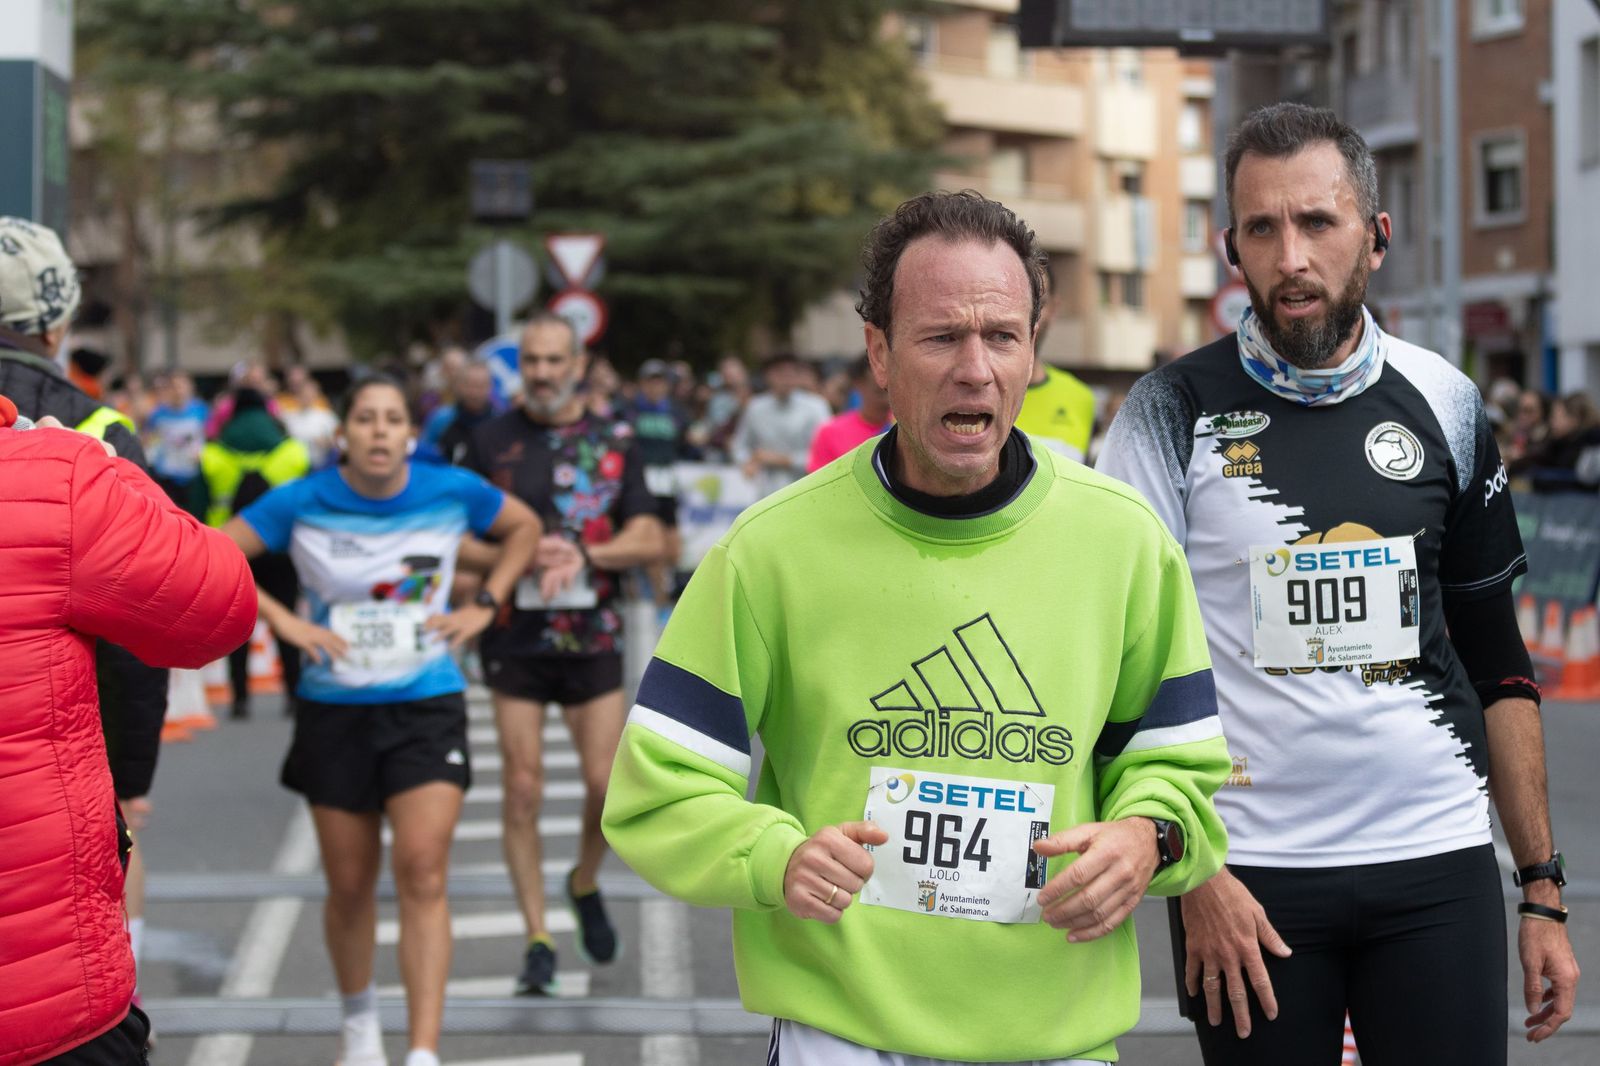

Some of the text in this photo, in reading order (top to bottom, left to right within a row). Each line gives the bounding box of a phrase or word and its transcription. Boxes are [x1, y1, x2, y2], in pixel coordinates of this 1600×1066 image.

[1294, 546, 1401, 572] SETEL
[1287, 575, 1367, 626] 909
[1315, 625, 1343, 636] ALEX
[1327, 643, 1372, 653] Ayuntamiento
[1338, 653, 1372, 662] Salamanca
[1361, 667, 1408, 686] grupo
[847, 708, 1074, 766] adidas
[918, 780, 1036, 813] SETEL
[902, 809, 992, 872] 964
[929, 868, 960, 881] LOLO
[940, 892, 990, 906] Ayuntamiento
[939, 904, 989, 917] de Salamanca
